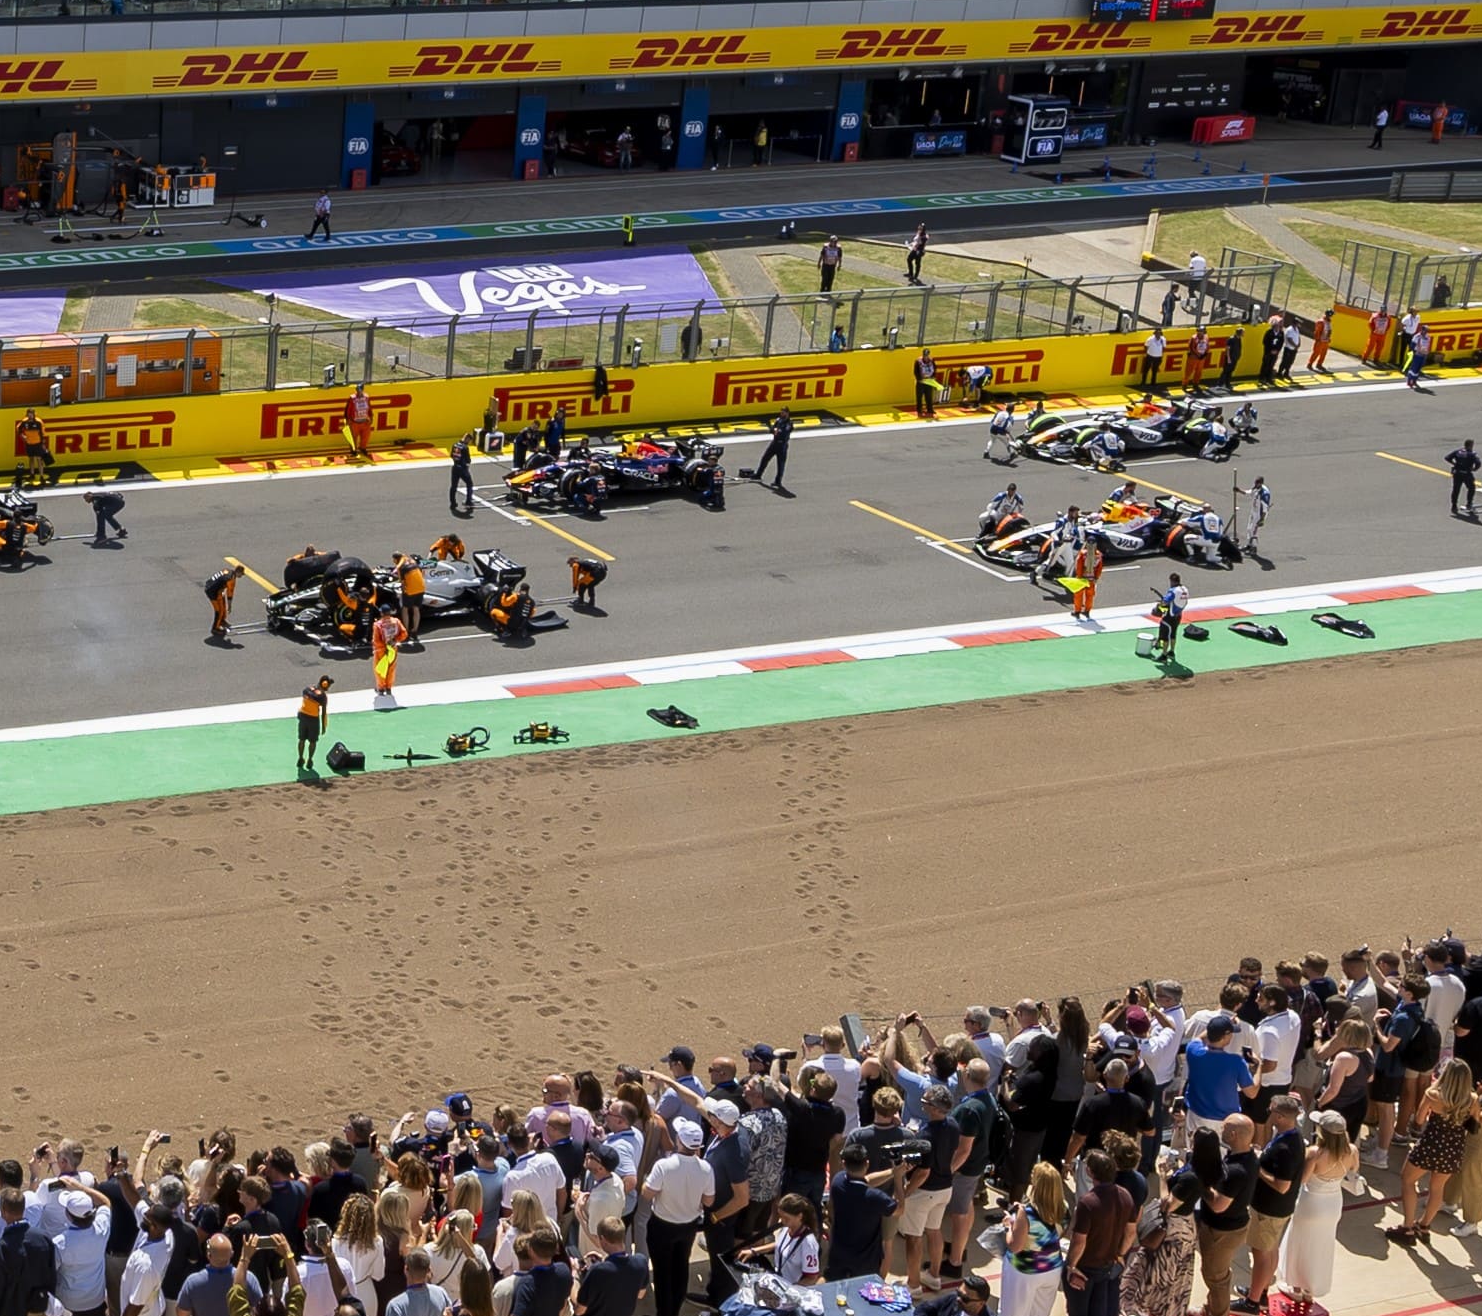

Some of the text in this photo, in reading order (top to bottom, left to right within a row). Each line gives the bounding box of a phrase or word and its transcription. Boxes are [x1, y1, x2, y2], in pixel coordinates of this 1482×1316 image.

[1207, 15, 1306, 43] DHL
[1378, 9, 1471, 36] DHL
[837, 28, 949, 59] DHL
[1030, 22, 1134, 51] DHL
[413, 43, 539, 76] DHL
[633, 35, 750, 68] DHL
[179, 51, 316, 86] DHL
[684, 121, 704, 136] FIA
[839, 113, 859, 128] FIA
[520, 130, 540, 144] FIA
[1219, 128, 1245, 138] SPRINT
[348, 140, 369, 154] FIA
[1037, 142, 1055, 153] FIA
[1121, 175, 1269, 193] aramco
[928, 188, 1081, 205] aramco
[718, 200, 881, 218] aramco
[493, 215, 666, 235] aramco
[359, 271, 646, 316] Vegas
[713, 363, 848, 406] PIRELLI
[494, 379, 635, 422] PIRELLI
[1139, 431, 1159, 441] VISA
[623, 467, 659, 482] ORACLE
[1117, 538, 1140, 549] VISA
